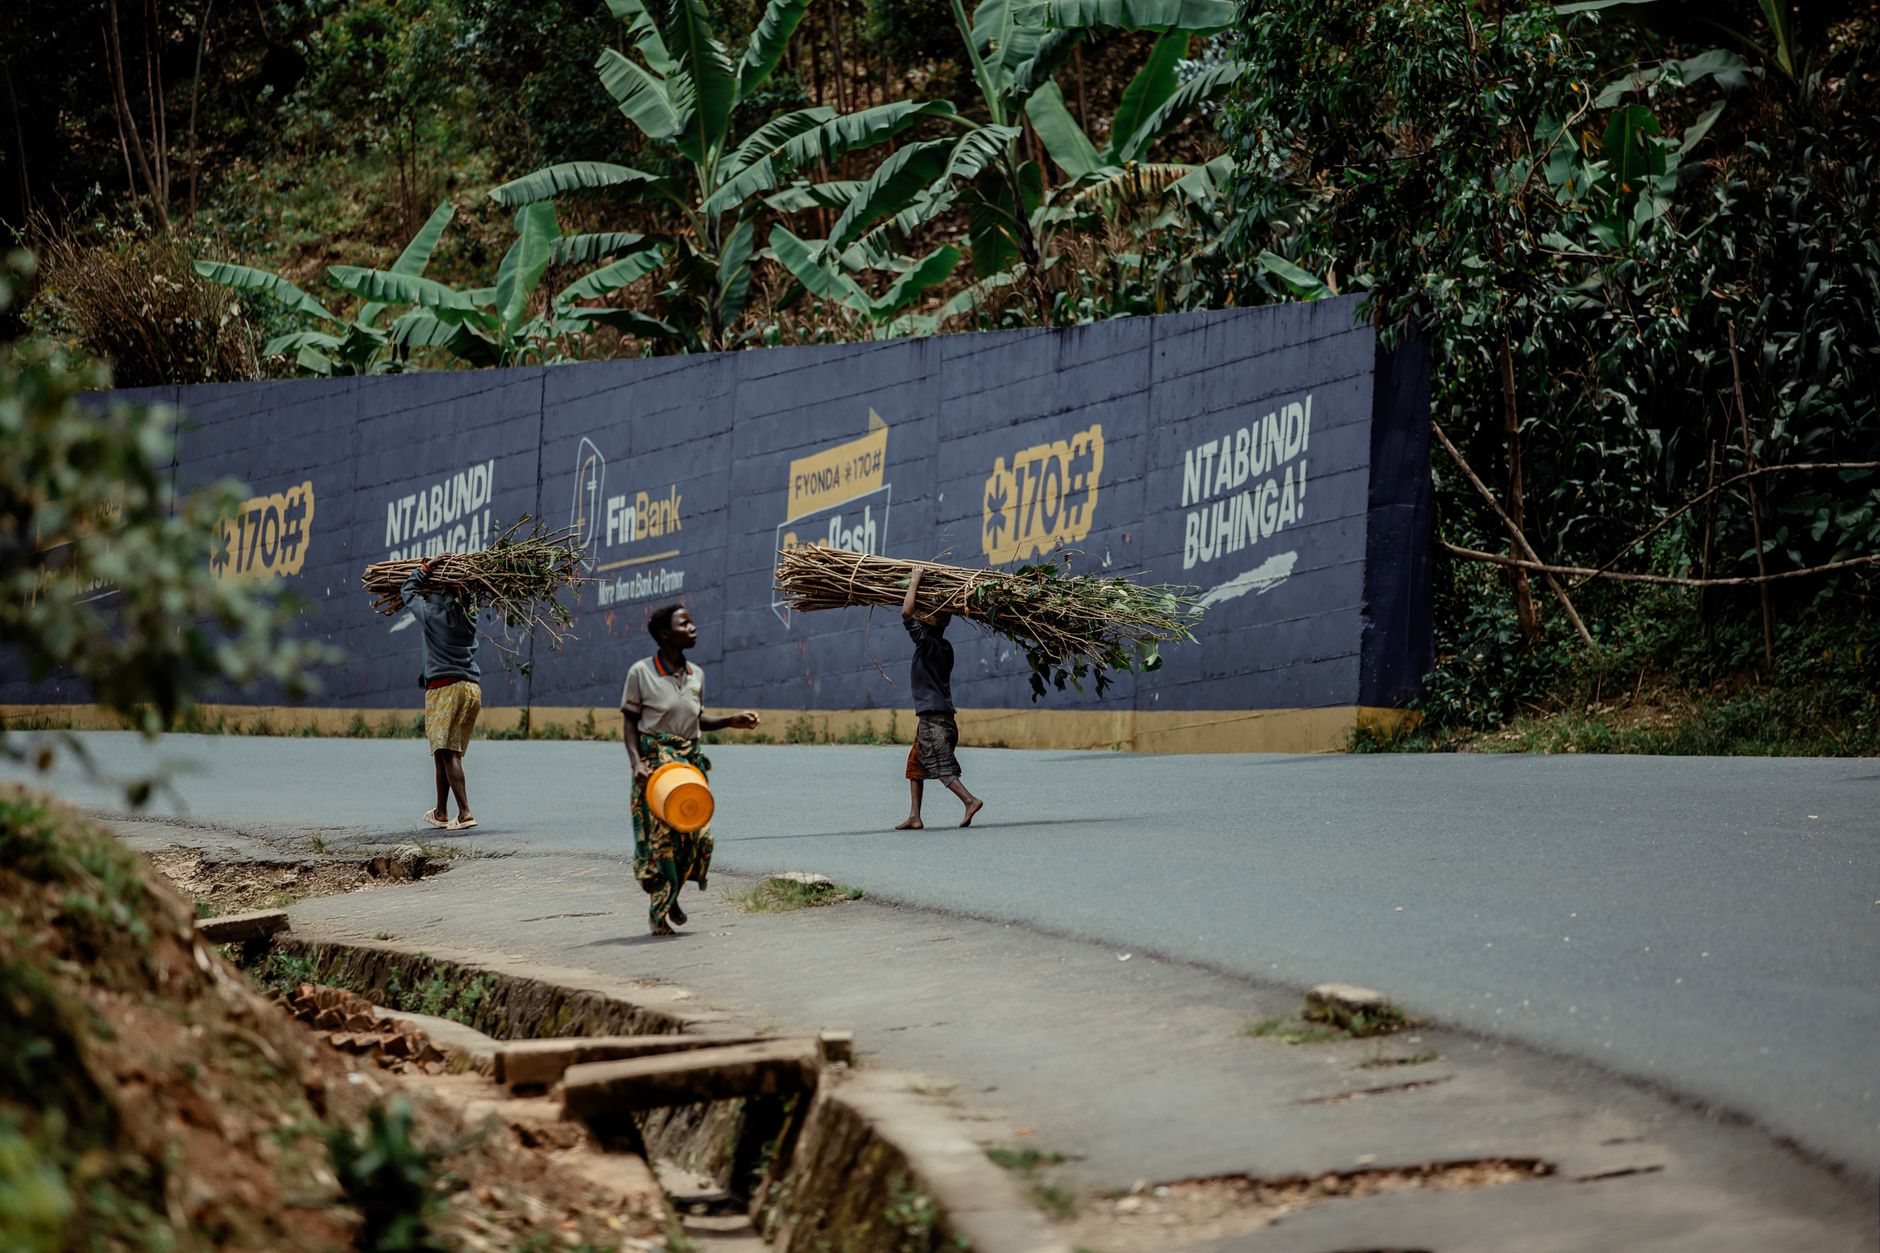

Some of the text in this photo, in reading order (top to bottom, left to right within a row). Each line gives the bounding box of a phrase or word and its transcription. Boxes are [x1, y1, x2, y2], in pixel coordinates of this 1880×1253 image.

[795, 464, 840, 500] FYONDA
[1182, 395, 1312, 507] NTABUNDI
[385, 459, 494, 548] NTABUNDI
[606, 484, 682, 547] FinBank
[783, 505, 876, 557] flash
[1183, 459, 1307, 570] BUHINGA!
